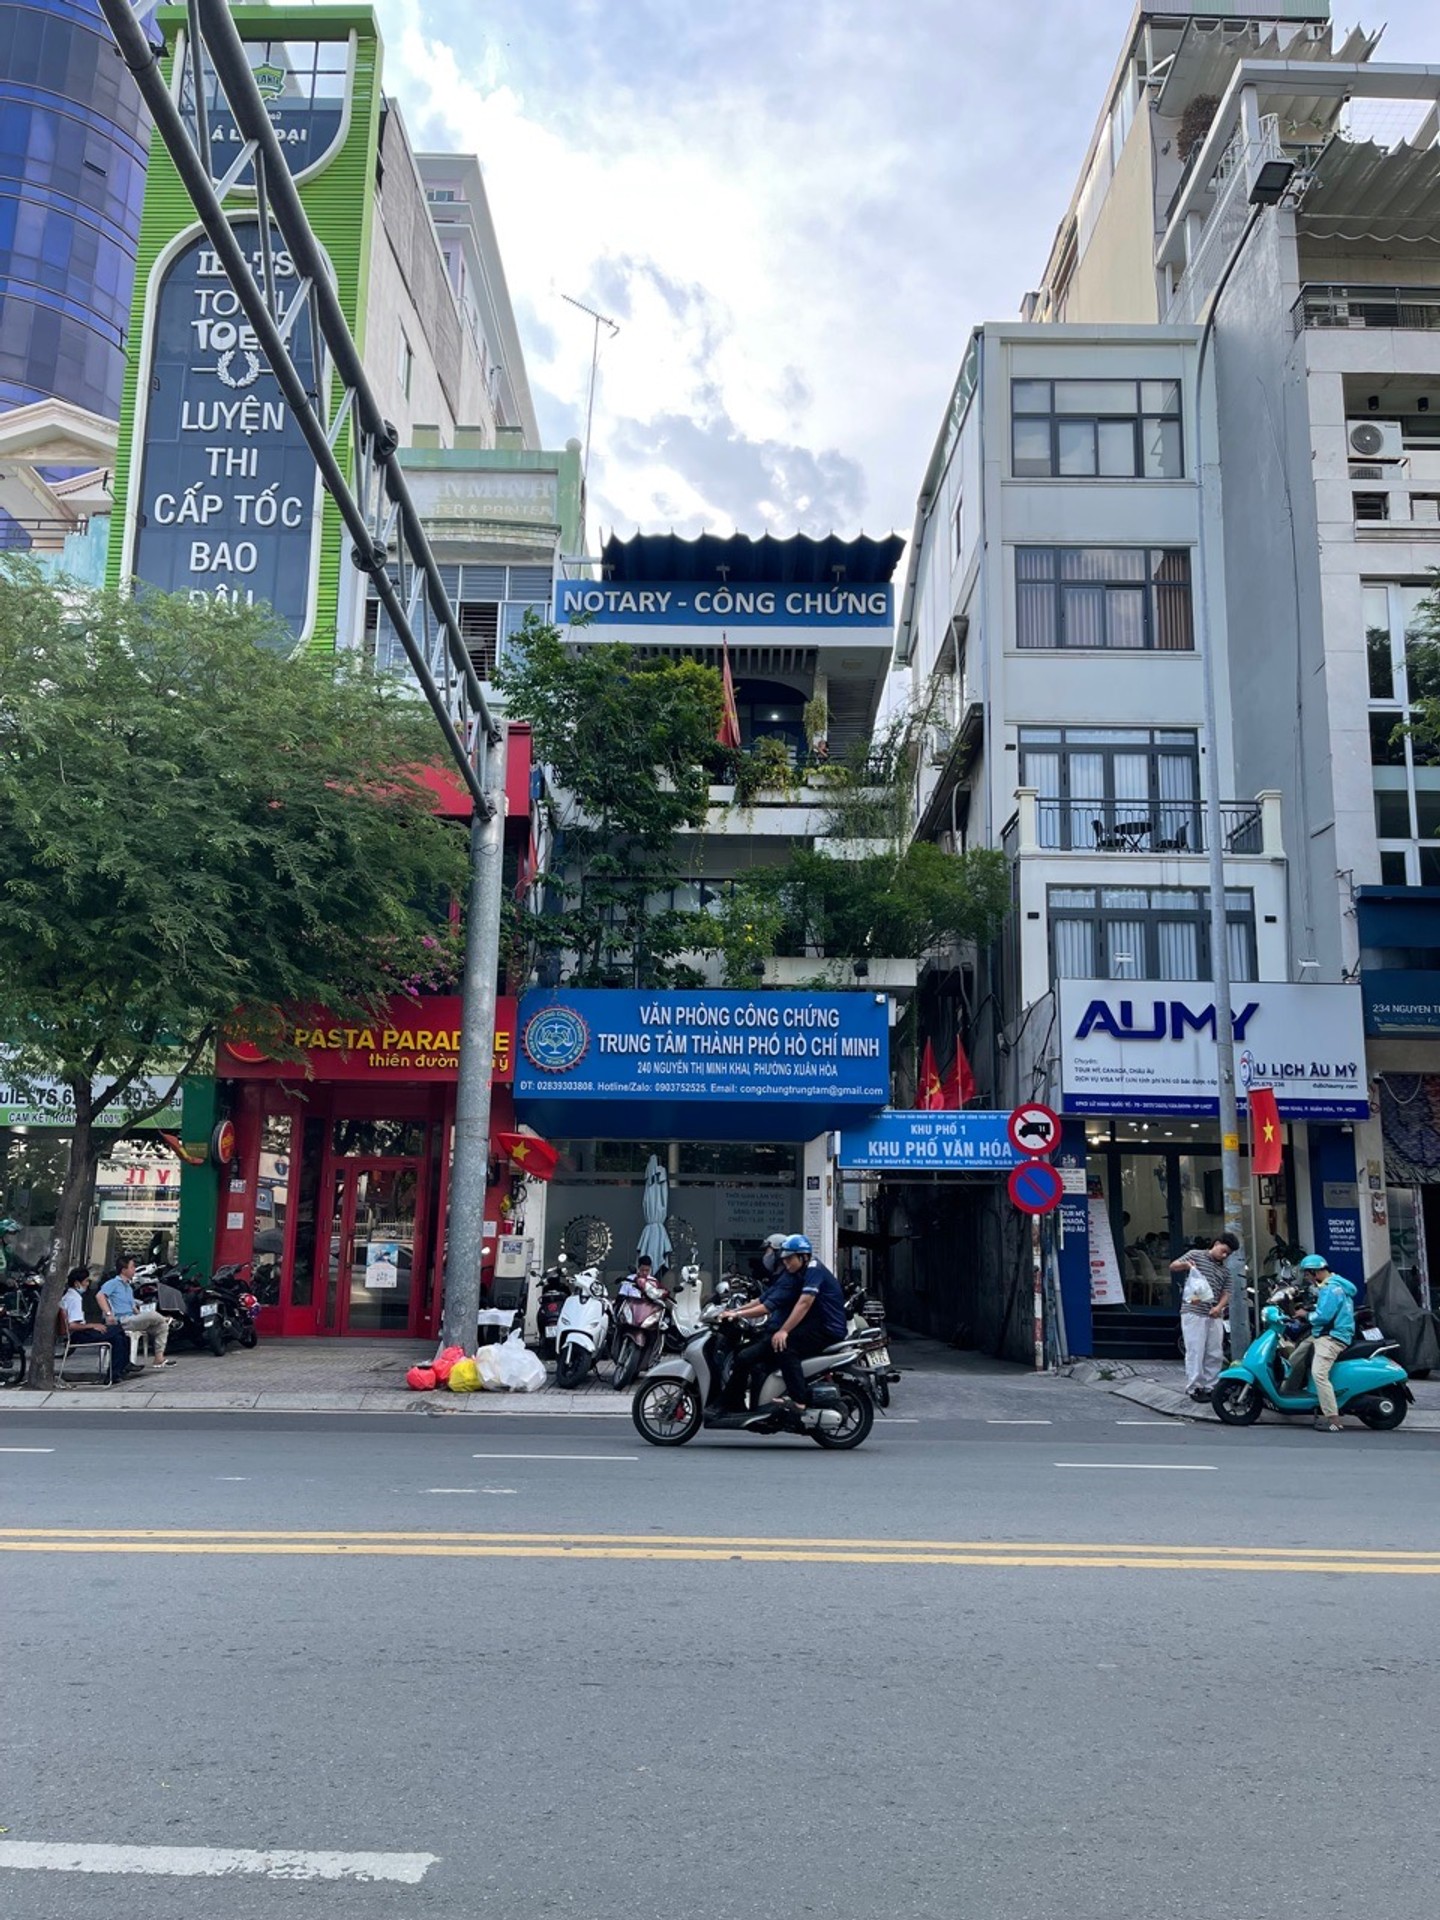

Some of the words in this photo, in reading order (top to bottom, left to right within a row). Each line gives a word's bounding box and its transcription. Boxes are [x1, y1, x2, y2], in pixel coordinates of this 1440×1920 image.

[197, 251, 296, 276] IETS
[181, 395, 285, 435] LUYỆN
[205, 447, 258, 477] THI
[154, 482, 223, 525] CẤP
[234, 482, 302, 527] TỐC
[189, 541, 258, 572] BAO
[563, 590, 671, 613] NOTARY
[694, 587, 775, 614] CÔNG
[785, 587, 887, 615] CHỨNG
[640, 1001, 671, 1025] VĂN
[676, 1002, 730, 1026] PHÒNG
[734, 1003, 779, 1027] CÔNG
[783, 1004, 840, 1028] CHỨNG
[1074, 1000, 1260, 1041] AUMY
[1372, 1004, 1390, 1012] 234
[293, 1029, 376, 1050] PASTA
[382, 1030, 510, 1052] PARADE
[598, 1034, 650, 1053] TRUNG
[655, 1029, 687, 1054] TÂM
[692, 1030, 743, 1055] THÀNH
[811, 1032, 838, 1056] CHÍ
[841, 1038, 879, 1057] MINH
[369, 1053, 409, 1068] thiên
[415, 1053, 459, 1069] đườn
[637, 1062, 650, 1074] 240
[690, 1062, 704, 1076] THỊ
[706, 1062, 728, 1075] MINH
[793, 1062, 817, 1076] XUÂN
[819, 1062, 838, 1077] HÒA
[1271, 1063, 1305, 1079] LỊCH
[1309, 1062, 1330, 1077] ÂU
[1335, 1062, 1357, 1078] MỸ
[710, 1083, 738, 1094] Email:
[910, 1124, 932, 1135] KHU
[935, 1121, 957, 1136] PHỐ
[961, 1125, 966, 1135] 1
[868, 1141, 900, 1157] KHU
[905, 1136, 938, 1157] PHỐ
[942, 1139, 974, 1157] VĂN
[980, 1138, 1012, 1157] HÓA
